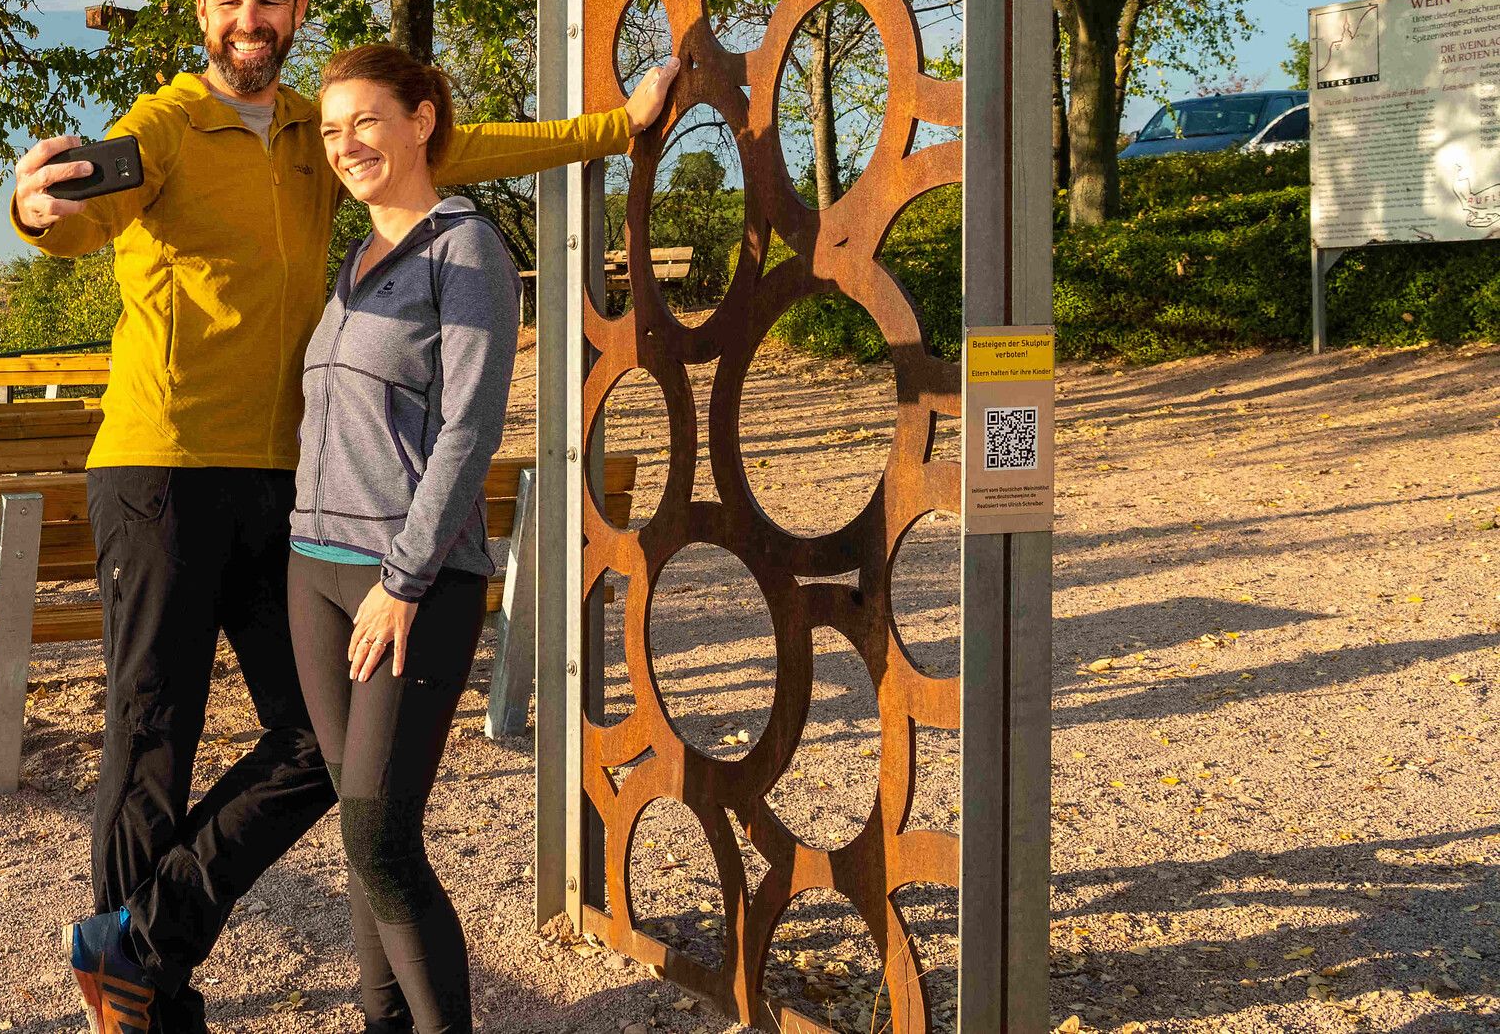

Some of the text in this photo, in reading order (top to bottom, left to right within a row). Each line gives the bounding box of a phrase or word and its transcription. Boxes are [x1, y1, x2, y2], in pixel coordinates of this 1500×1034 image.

[1441, 43, 1457, 54] DIE
[1441, 54, 1456, 63] AM
[1459, 50, 1490, 61] ROTEN
[1318, 74, 1379, 88] NIERSTEIN
[972, 340, 1007, 349] Besteigen
[1021, 339, 1050, 348] Skulptur
[995, 350, 1028, 358] verboten!
